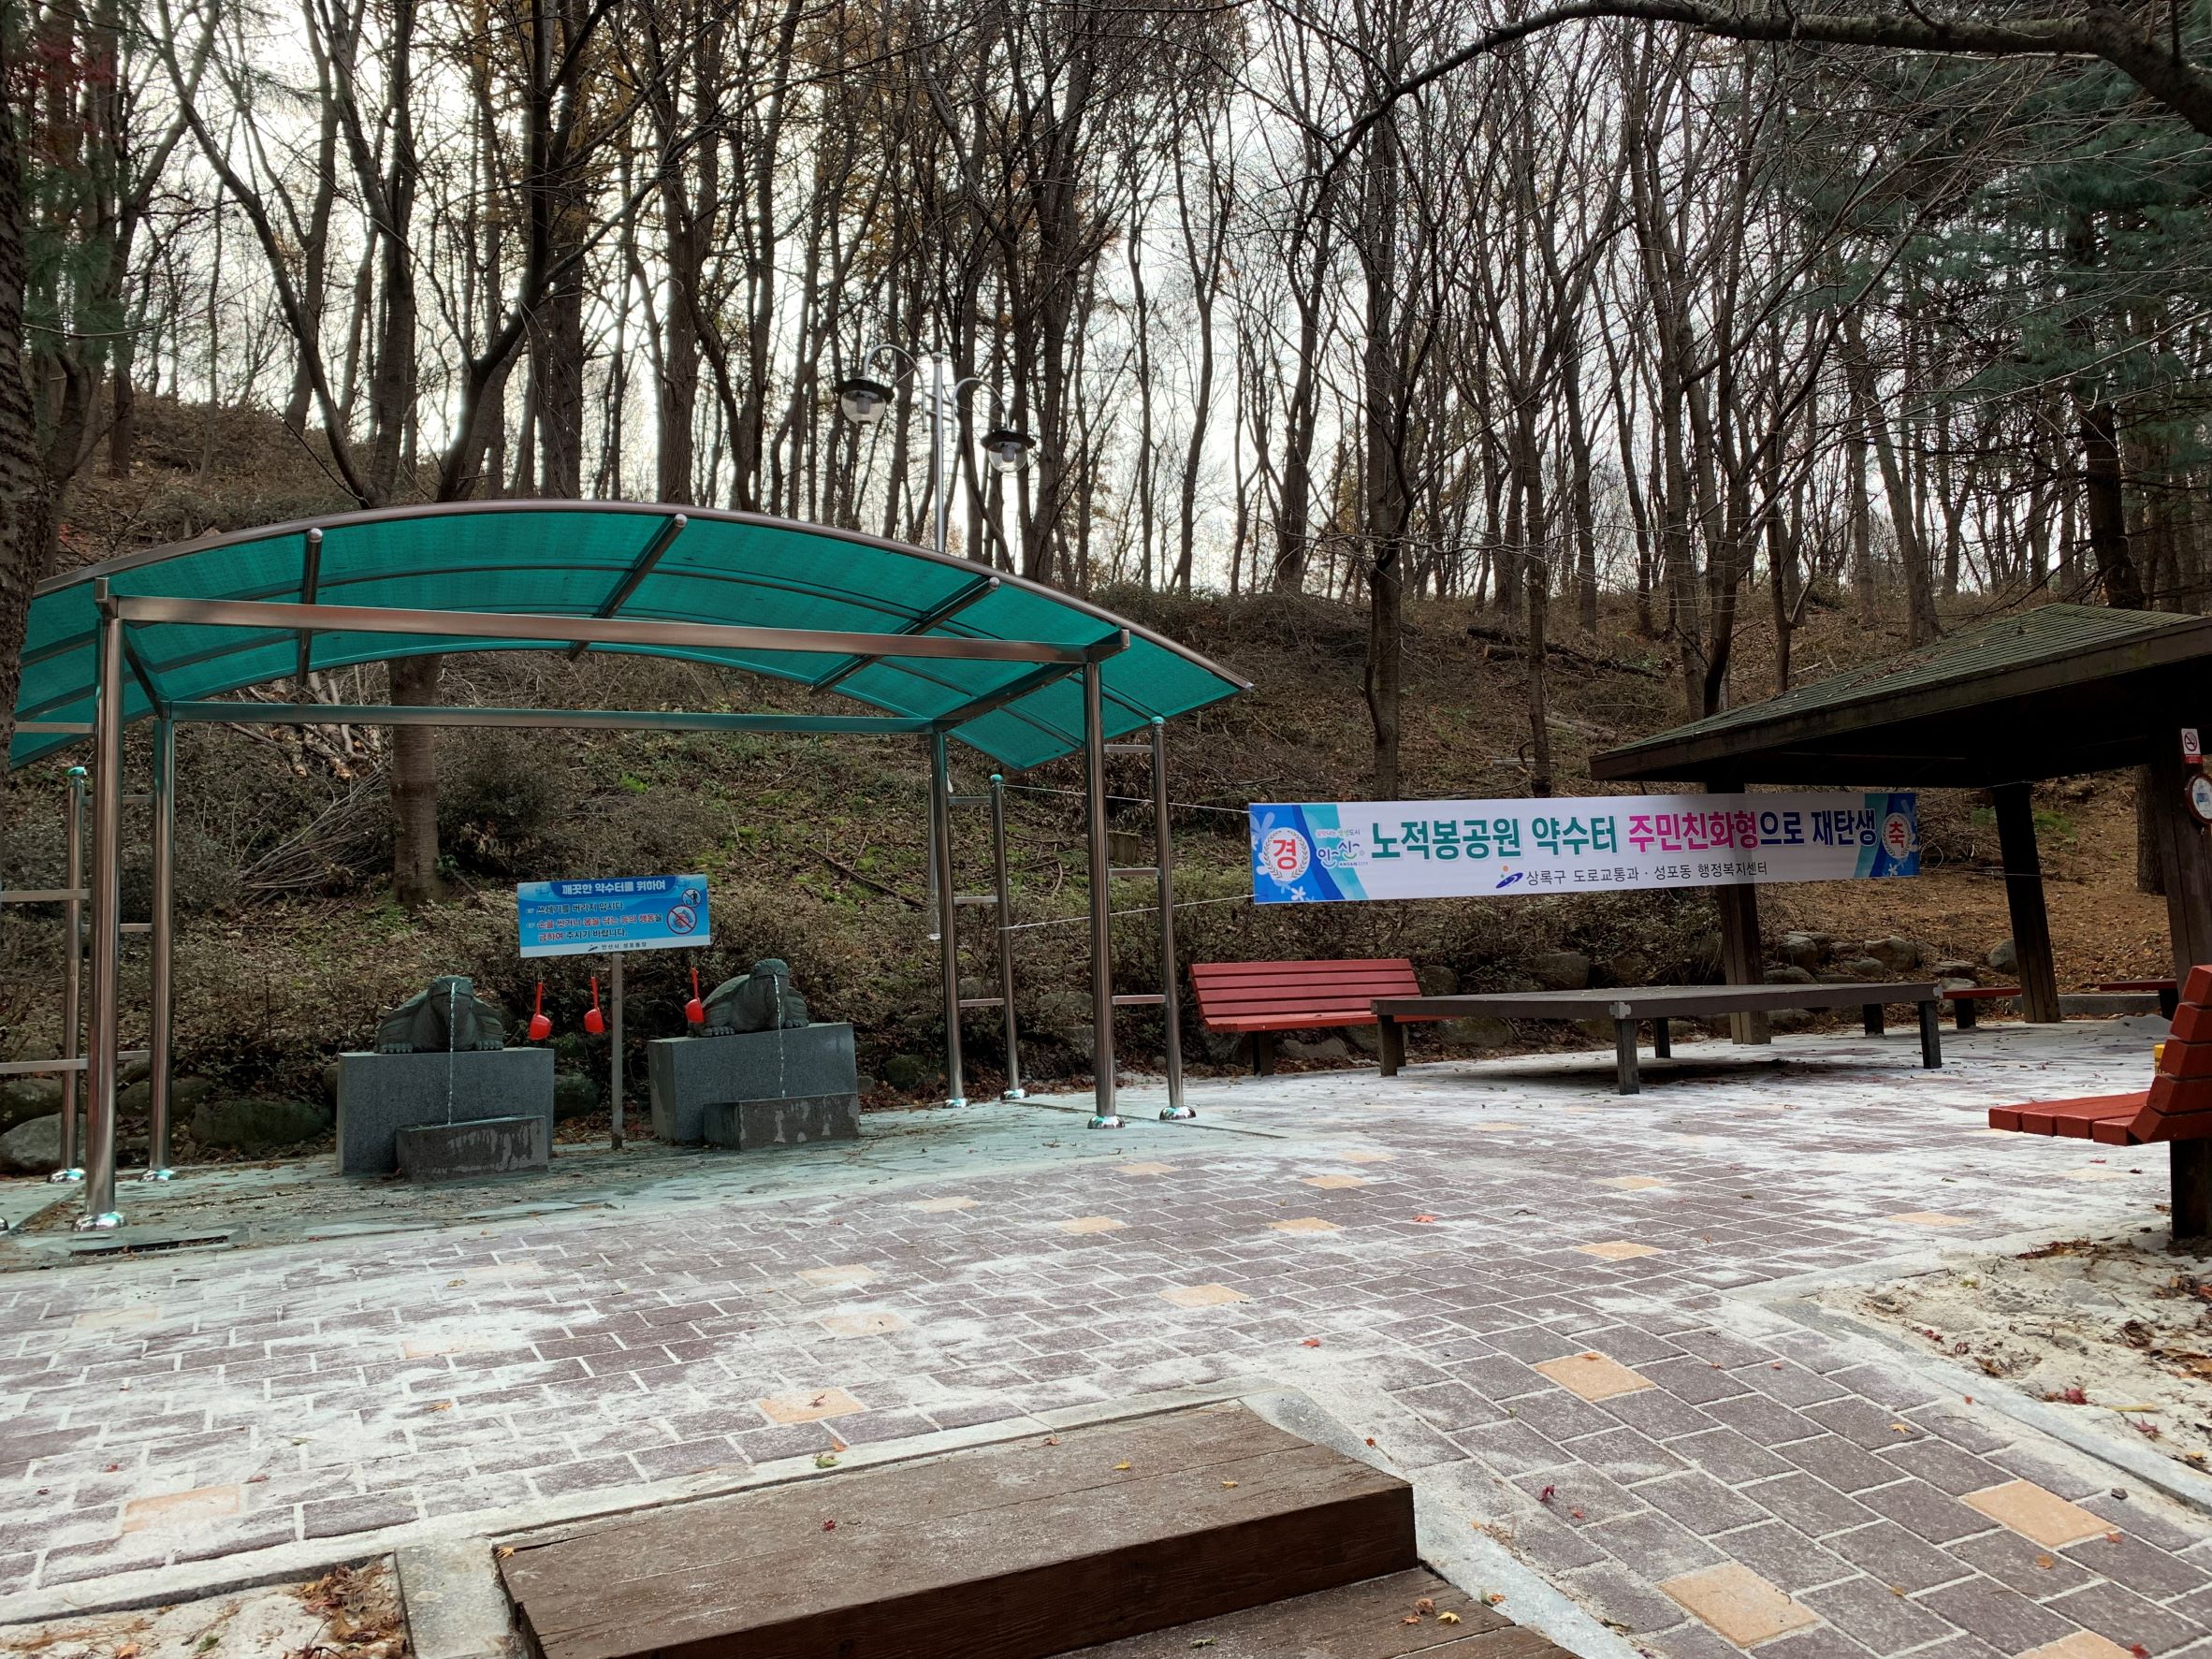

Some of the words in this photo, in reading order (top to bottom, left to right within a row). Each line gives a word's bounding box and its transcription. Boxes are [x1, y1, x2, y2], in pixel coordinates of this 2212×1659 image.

[1371, 817, 1522, 860] 노적봉공원
[1532, 814, 1618, 855] 약수터
[1628, 809, 1805, 853] 주민친화형으로
[1812, 808, 1877, 846] 재탄생
[1888, 821, 1906, 849] 축
[1273, 838, 1297, 870] 경
[1526, 870, 1566, 886] 상록구
[1574, 866, 1639, 883] 도로교통과
[1653, 864, 1692, 880] 성포동
[1697, 861, 1768, 879] 행정복지센터
[562, 883, 592, 895] 깨끗한
[595, 881, 634, 894] 약수터를
[636, 880, 666, 892] 위하여
[537, 904, 569, 914] 쓰레기를
[572, 902, 597, 912] 버리지
[565, 931, 590, 940] 주시기
